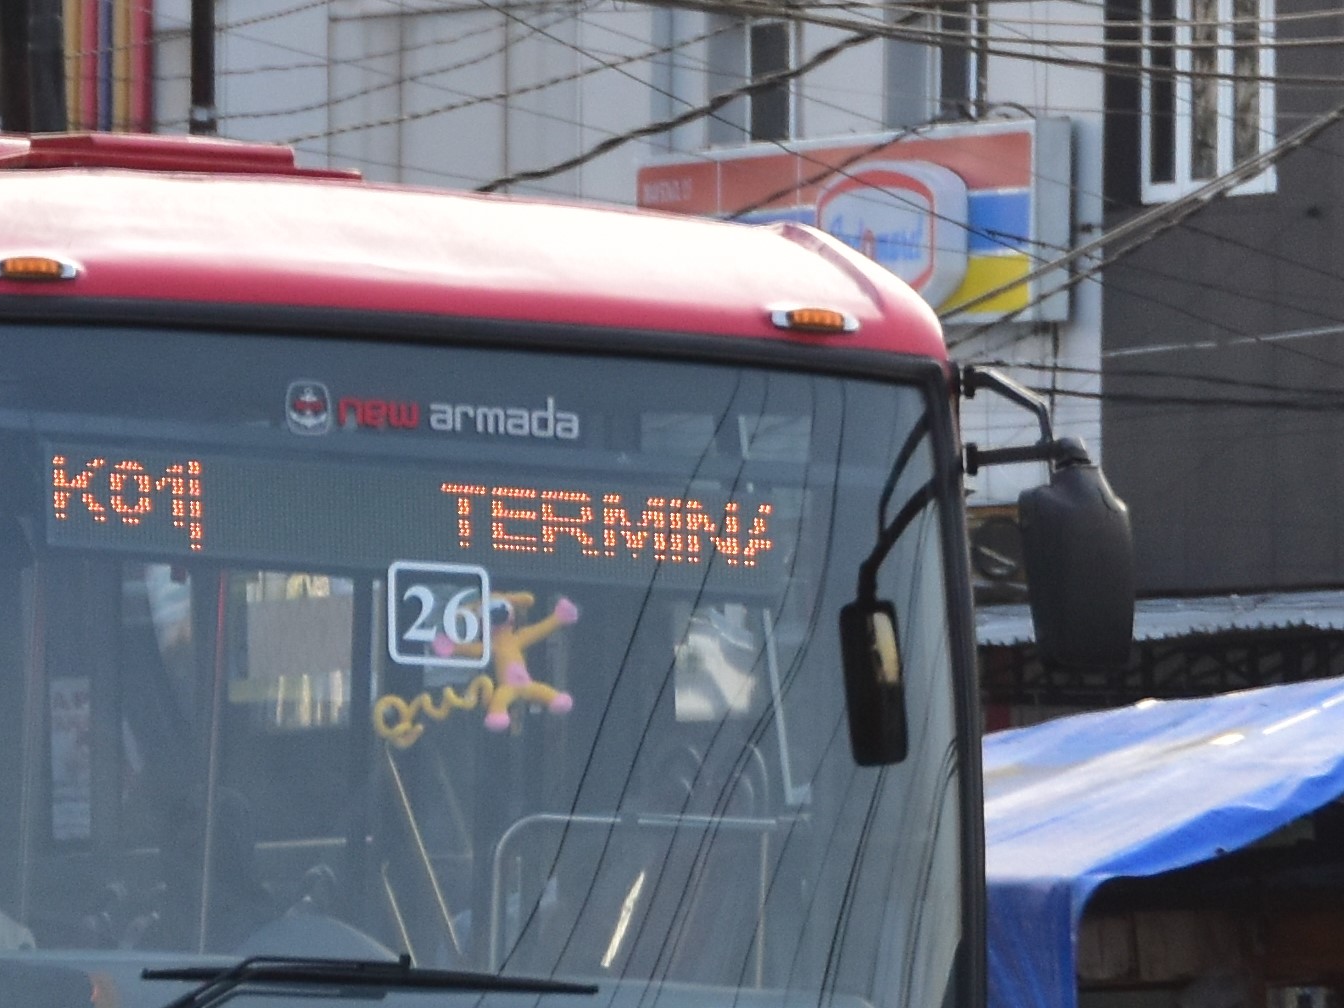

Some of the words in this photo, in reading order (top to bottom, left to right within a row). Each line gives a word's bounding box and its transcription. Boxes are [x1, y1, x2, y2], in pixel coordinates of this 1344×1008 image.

[338, 396, 420, 428] new
[429, 397, 579, 439] armada
[403, 585, 478, 645] 26
